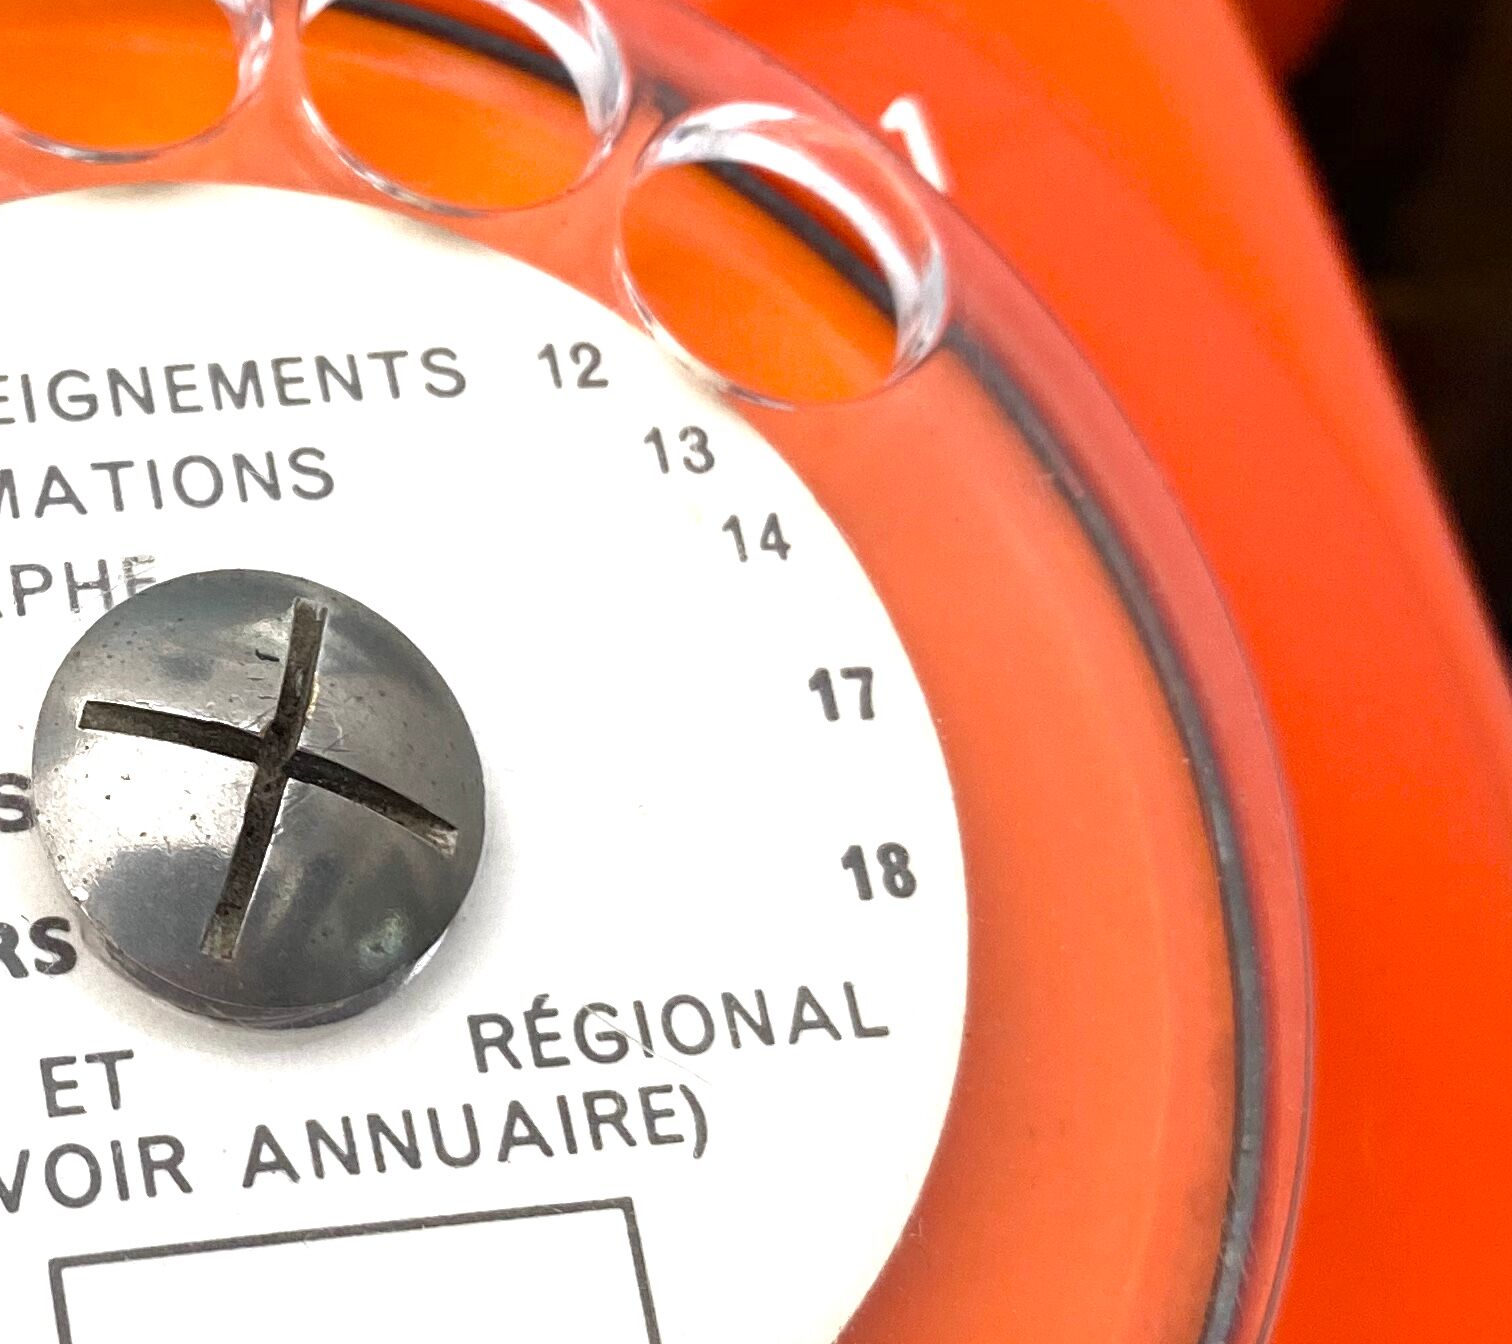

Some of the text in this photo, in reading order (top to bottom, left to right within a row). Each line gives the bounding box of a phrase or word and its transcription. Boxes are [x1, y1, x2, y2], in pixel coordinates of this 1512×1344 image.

[879, 95, 948, 193] 1
[537, 341, 610, 390] 12
[644, 425, 716, 475] 13
[722, 512, 792, 563] 14
[806, 665, 876, 722] 17
[840, 841, 918, 902] 18
[38, 1048, 136, 1119] ET
[465, 979, 892, 1075] RÉGIONAL
[241, 1081, 710, 1190] ANNUAIRE)
